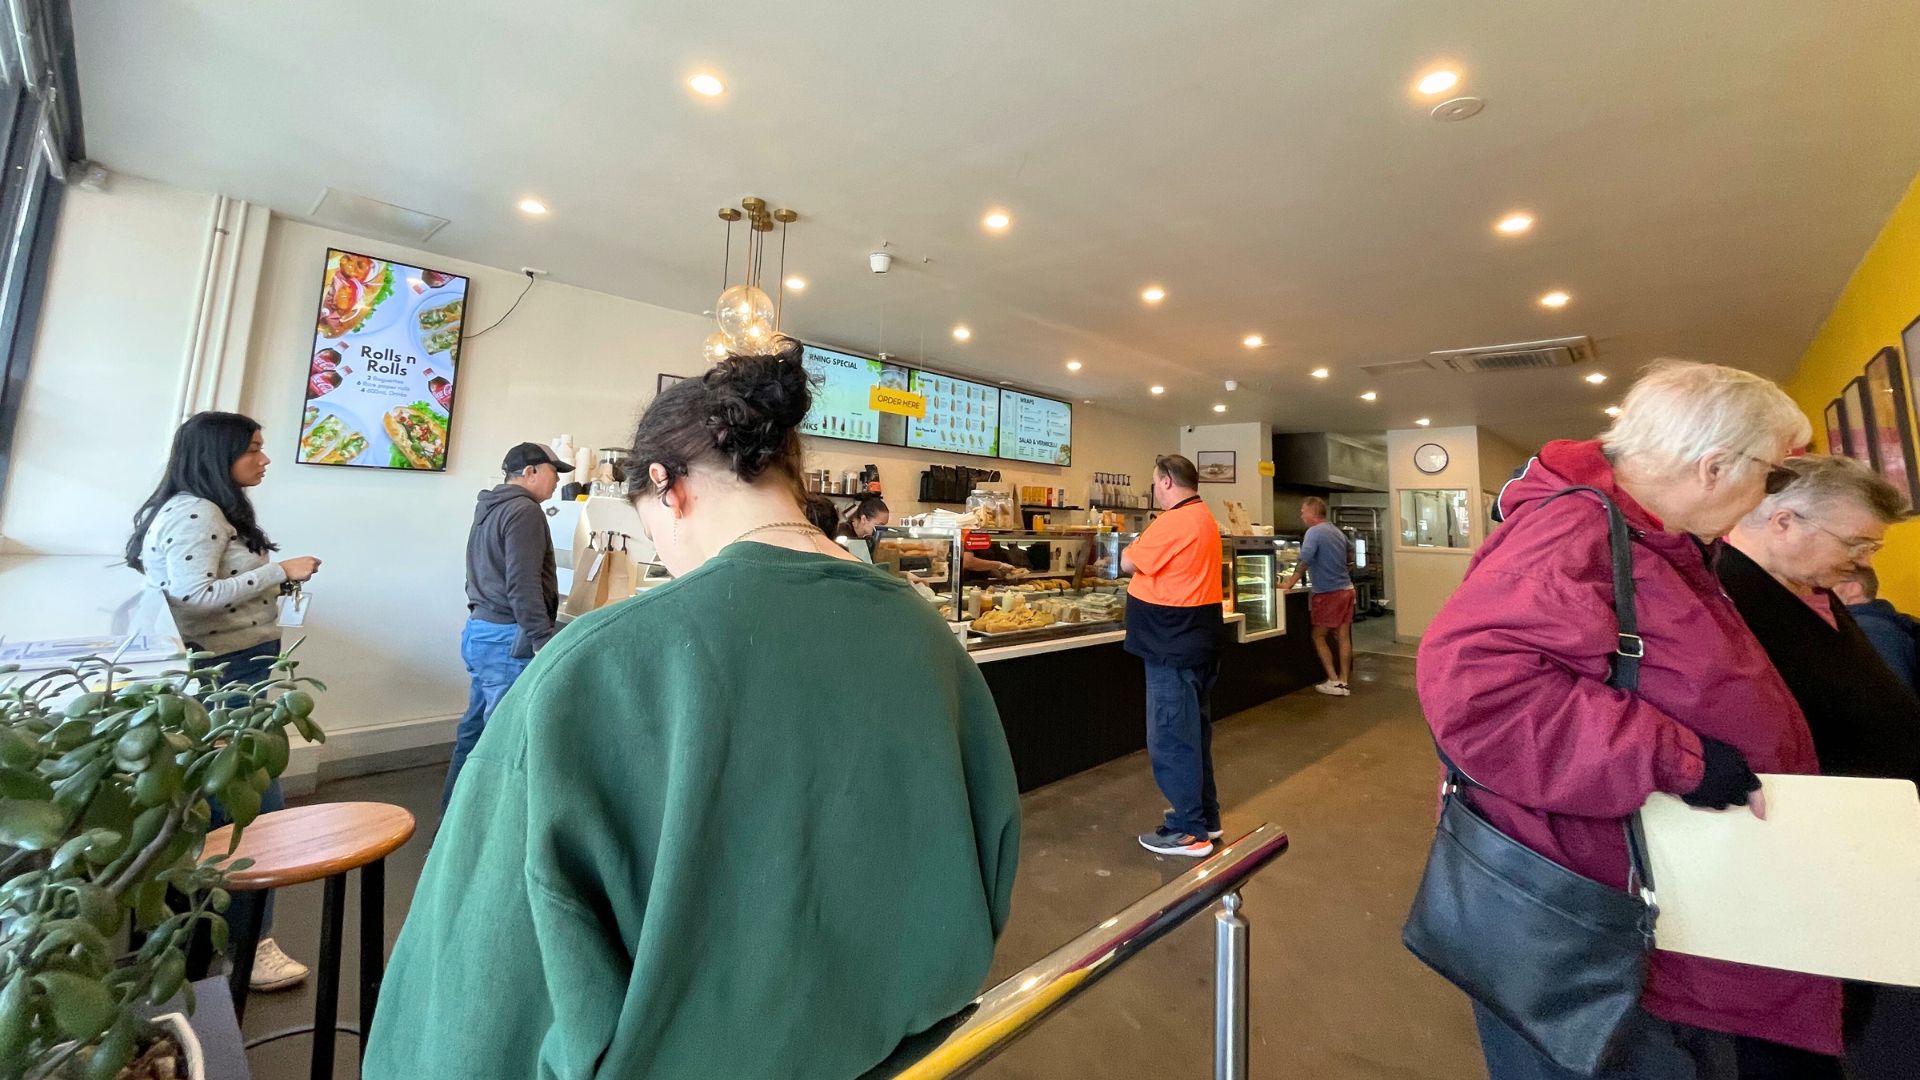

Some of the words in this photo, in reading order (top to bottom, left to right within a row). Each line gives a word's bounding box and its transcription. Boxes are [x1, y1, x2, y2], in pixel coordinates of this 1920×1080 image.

[361, 345, 402, 362] Rolls
[406, 356, 417, 365] n
[367, 359, 408, 376] Rolls
[832, 359, 858, 370] SPECIAL
[877, 394, 902, 406] ORDER
[902, 400, 920, 410] HERE
[1019, 397, 1035, 406] WRAPS
